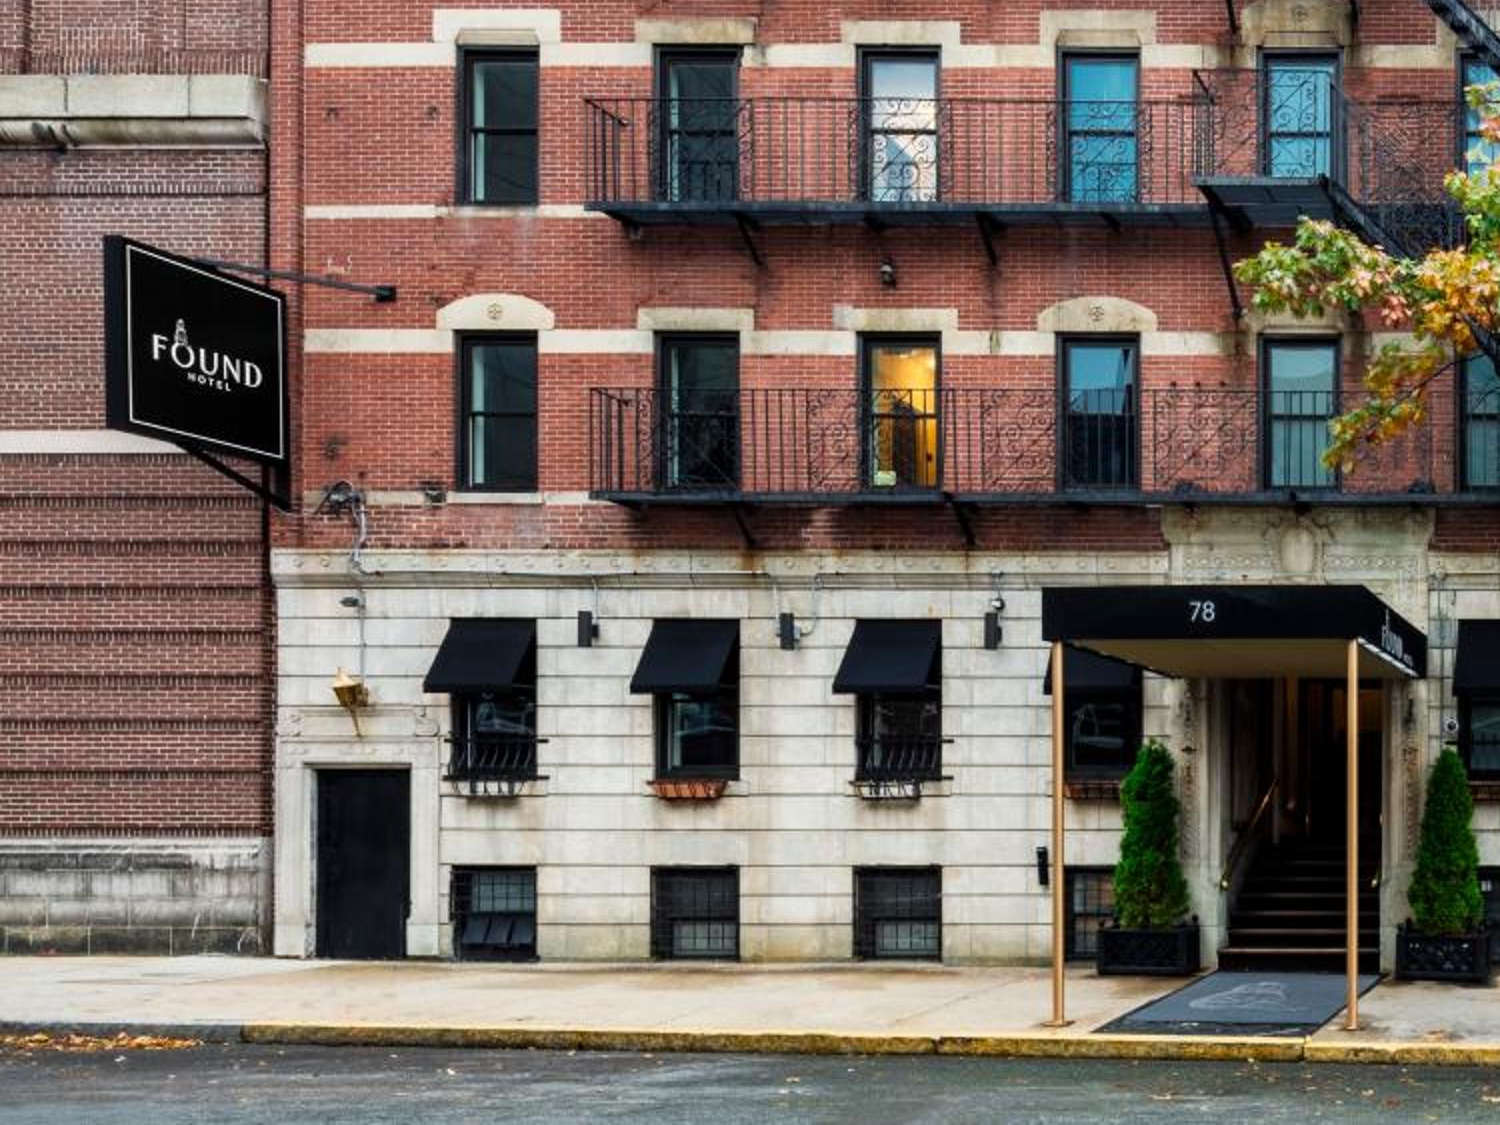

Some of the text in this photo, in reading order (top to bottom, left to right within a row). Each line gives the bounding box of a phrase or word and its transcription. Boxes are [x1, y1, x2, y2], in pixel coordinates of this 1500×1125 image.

[152, 332, 263, 389] FOUND
[187, 372, 231, 392] HOTEL
[1189, 601, 1216, 623] 78
